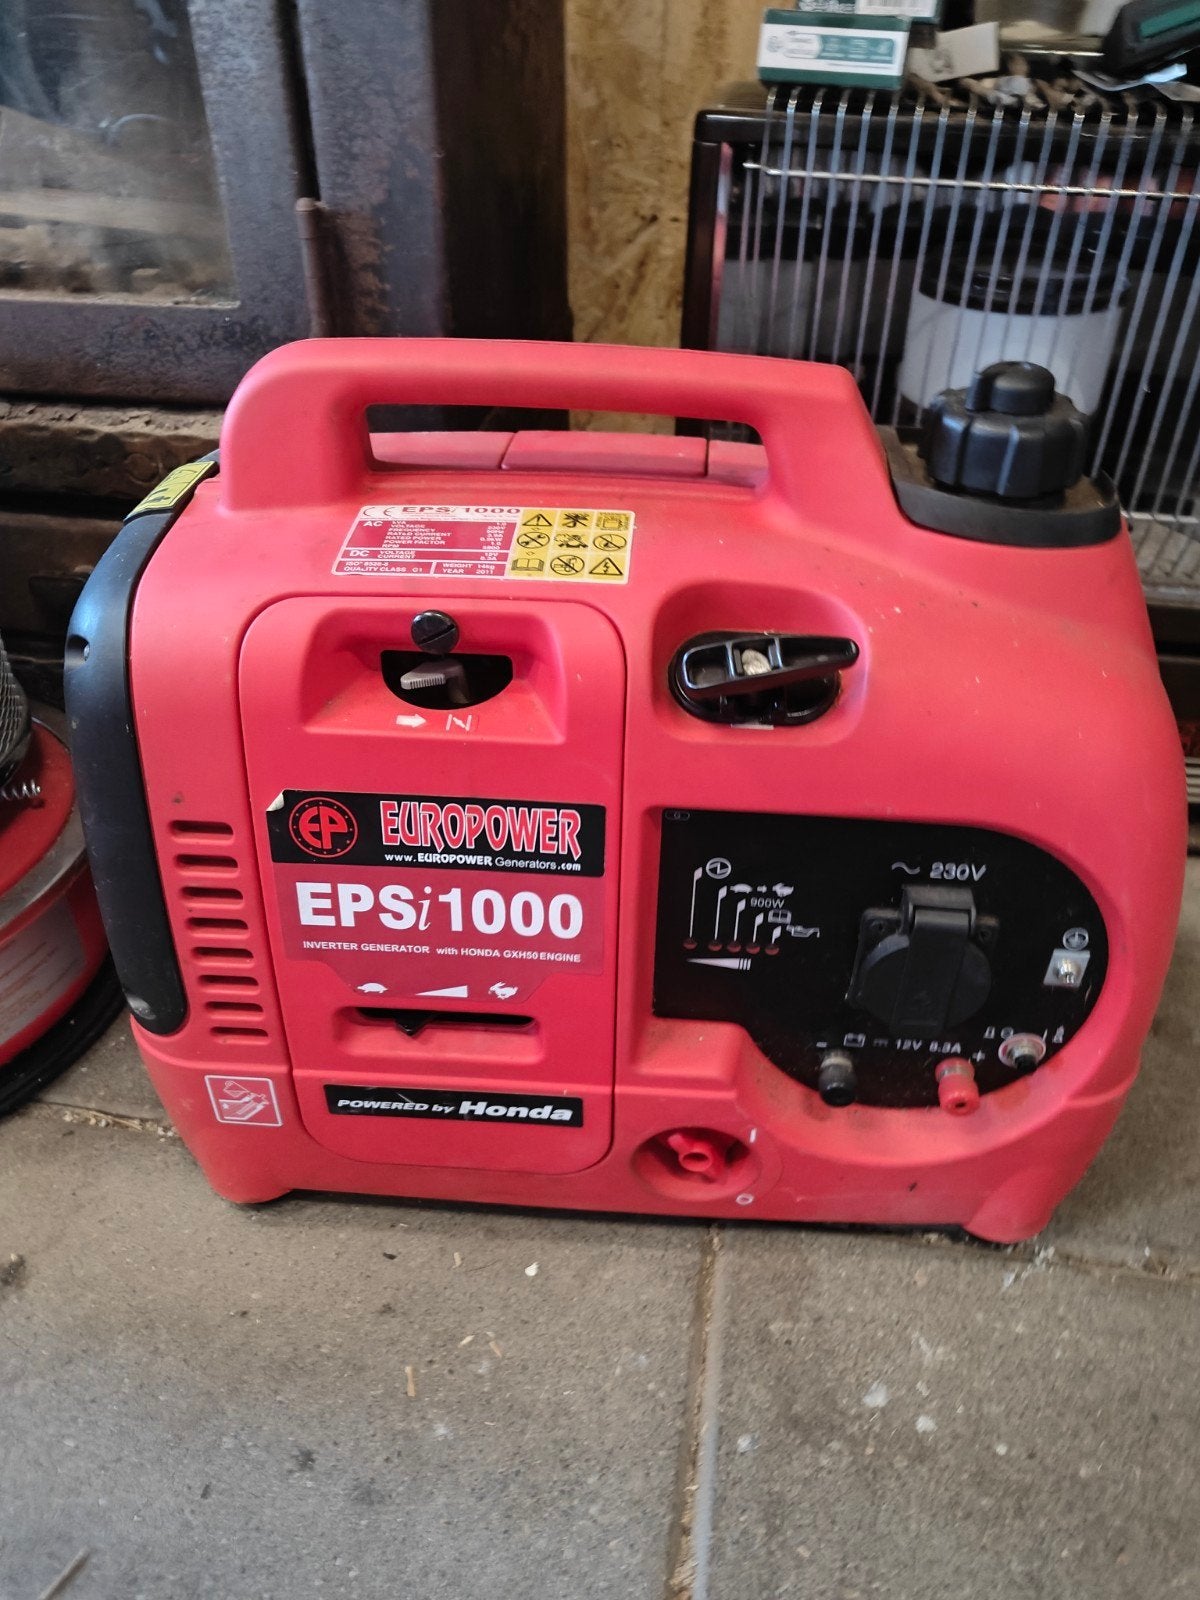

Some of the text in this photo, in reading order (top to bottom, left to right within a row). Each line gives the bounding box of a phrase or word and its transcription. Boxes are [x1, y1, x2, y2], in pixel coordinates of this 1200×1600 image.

[380, 800, 582, 861] EUROPOWER
[929, 861, 987, 881] 230V
[303, 940, 582, 963] INVERTER GENERATOR with HONDA GXH50 ENGINE
[337, 1099, 574, 1122] POWERED by Honda
